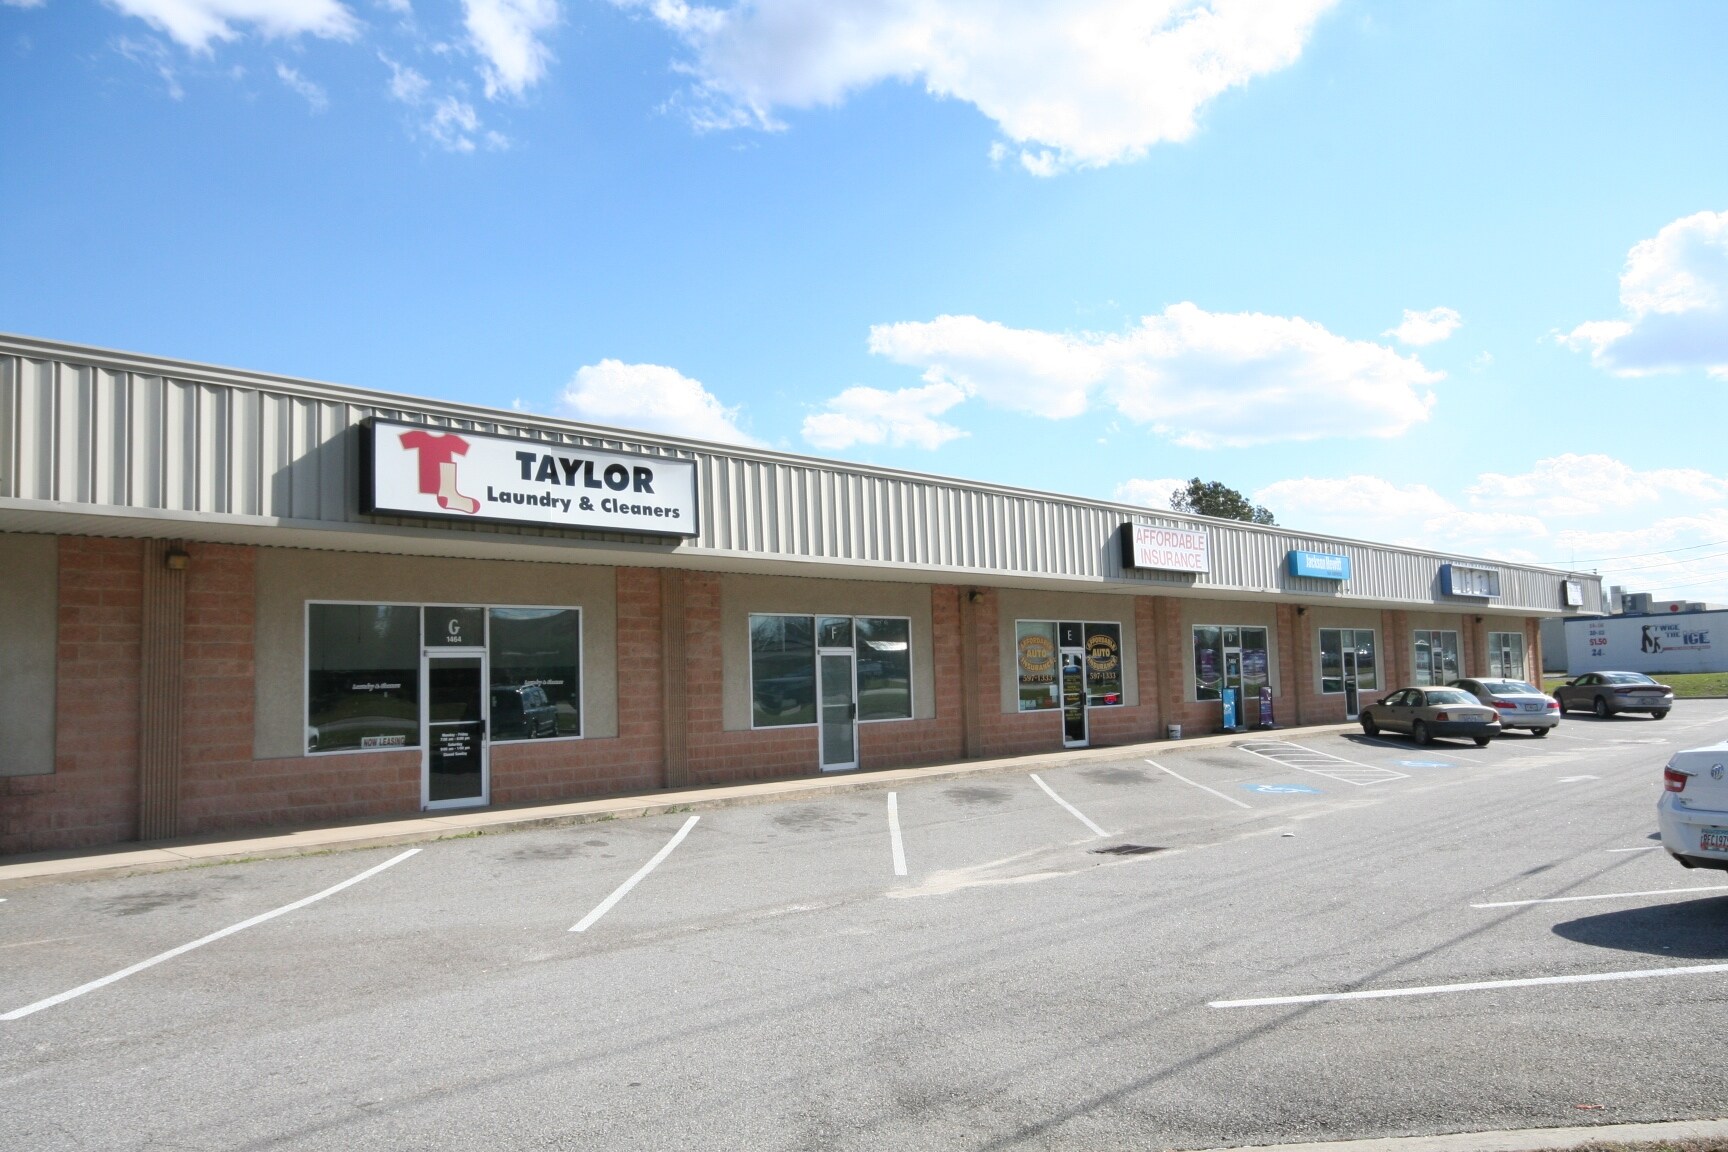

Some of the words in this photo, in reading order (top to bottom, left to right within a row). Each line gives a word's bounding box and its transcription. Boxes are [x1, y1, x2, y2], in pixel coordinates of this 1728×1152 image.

[515, 450, 655, 495] TAYLOR
[487, 486, 571, 513] Laundry
[579, 496, 595, 511] &
[601, 498, 680, 518] Cleaners
[1136, 527, 1205, 551] AFFORDABLE
[1140, 548, 1202, 569] INSURANCE
[448, 619, 461, 635] G
[831, 626, 837, 640] F
[1067, 630, 1073, 640] E
[1683, 631, 1711, 645] ICE
[1027, 649, 1047, 657] AUTO
[1092, 648, 1111, 657] AUTO
[363, 738, 378, 747] NOW
[379, 736, 405, 746] LEASING
